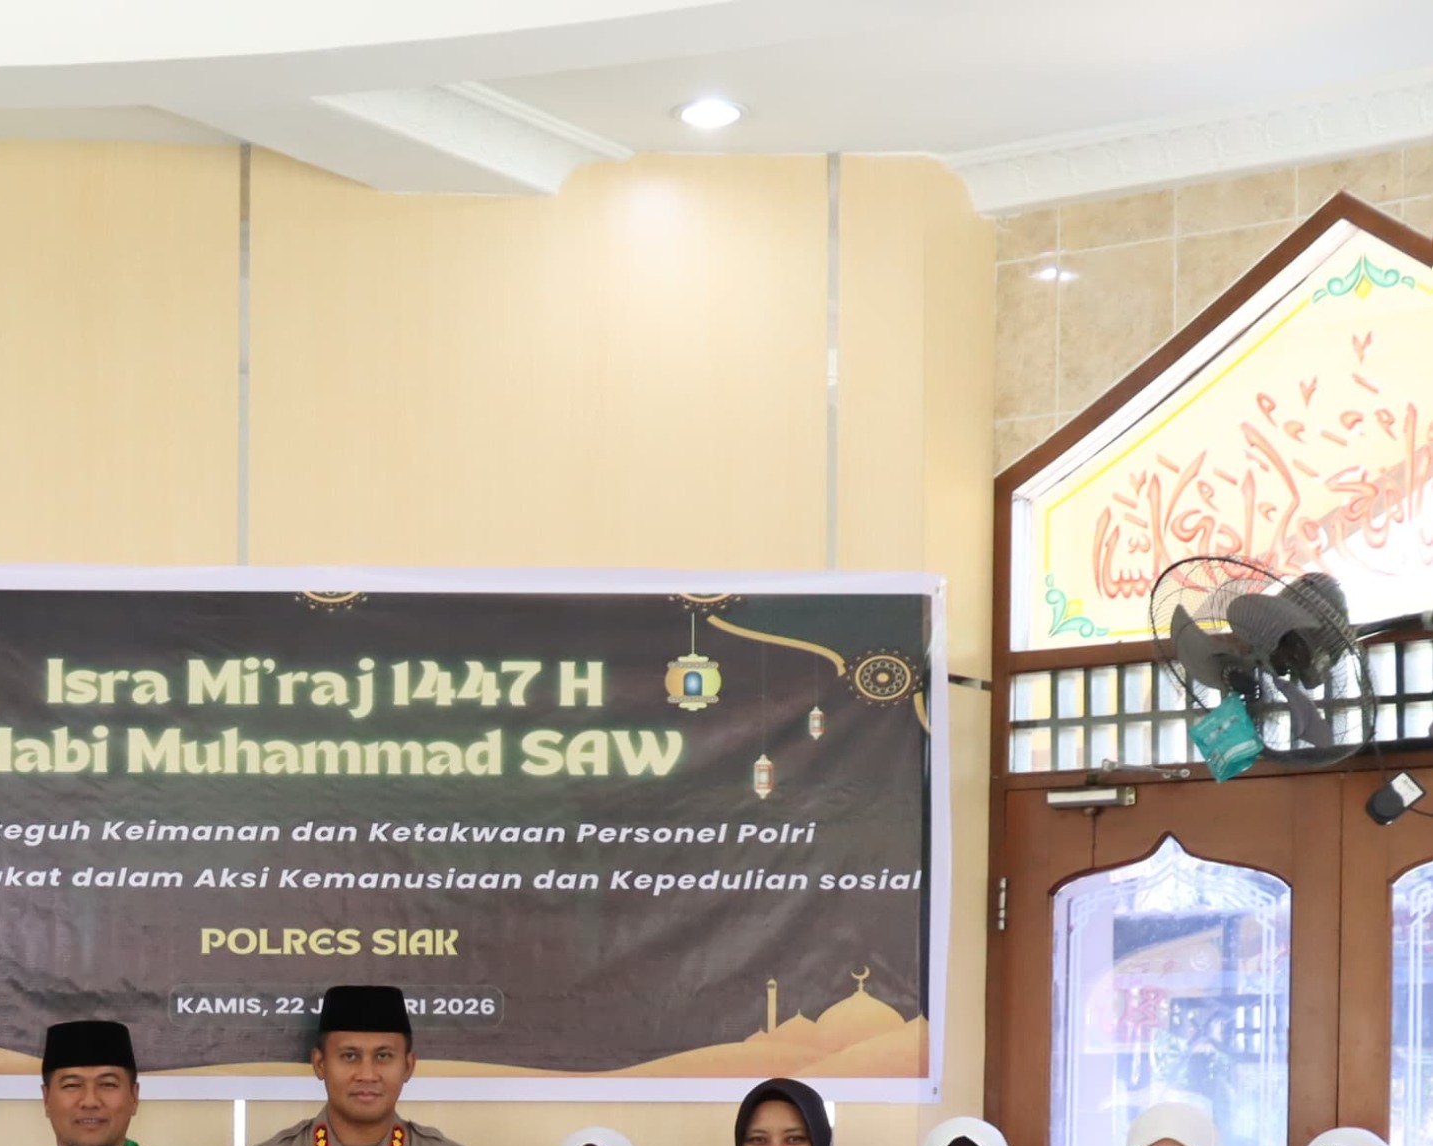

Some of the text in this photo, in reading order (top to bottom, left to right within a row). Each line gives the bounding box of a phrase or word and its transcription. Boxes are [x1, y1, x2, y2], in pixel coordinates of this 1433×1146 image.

[46, 657, 604, 719] Isra Mi'raj 1447 H
[127, 727, 502, 776] Muhammad
[521, 730, 683, 777] SAW
[101, 819, 280, 842] Keimanan
[291, 821, 357, 842] dan
[368, 822, 566, 843] Ketakwaan
[576, 823, 728, 843] Personel
[737, 822, 816, 844] Polri
[71, 866, 184, 888] dalam
[193, 866, 270, 888] Aksi
[278, 867, 522, 889] Kemanusiaan
[533, 869, 599, 890] dan
[610, 868, 808, 896] Kepedulian
[819, 868, 922, 890] sosial
[201, 927, 459, 957] POLRES SIAK
[177, 997, 269, 1017] KAMIS,
[275, 997, 305, 1015] 22
[432, 998, 496, 1016] 2026
